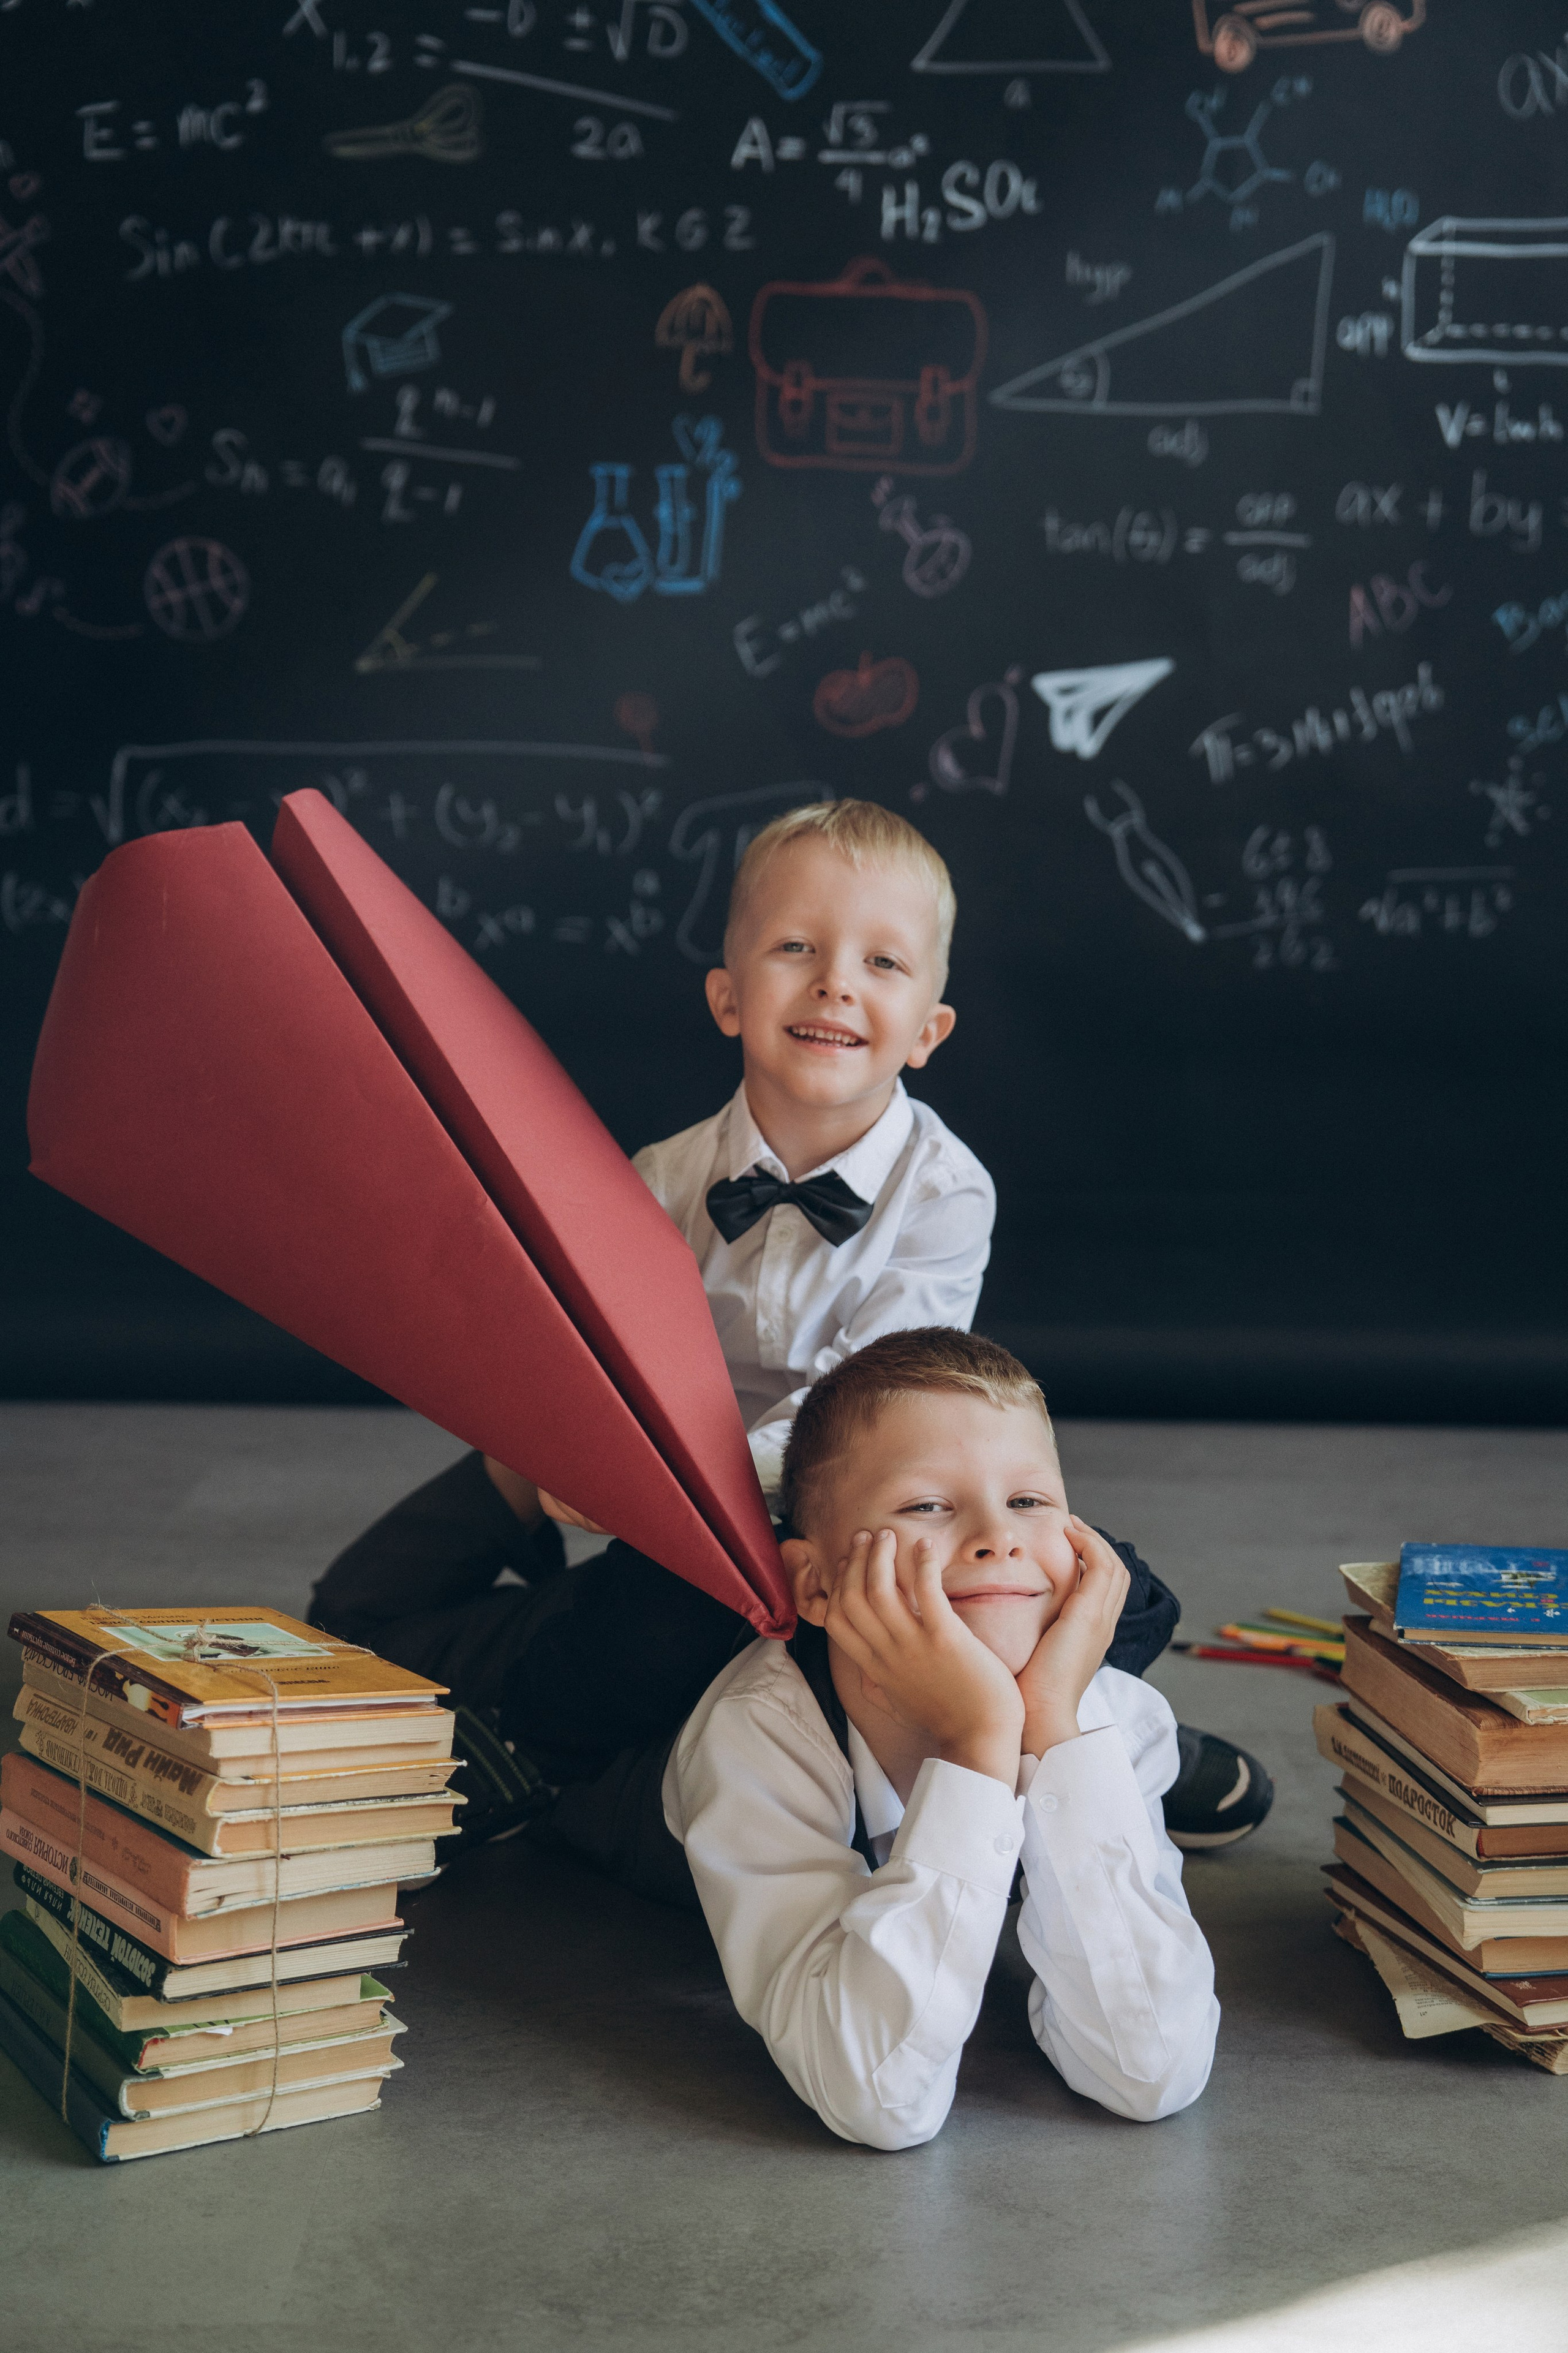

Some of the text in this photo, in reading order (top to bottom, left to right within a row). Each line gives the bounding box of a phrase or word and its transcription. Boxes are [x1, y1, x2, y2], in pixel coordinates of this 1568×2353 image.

[26, 1698, 205, 1796] Майн Рид КВАРТЕРОНКА
[1387, 1773, 1457, 1838] ПОДРОСТОК
[32, 1835, 69, 1875] ИСТОРИЯ
[21, 1874, 63, 1911] ИЛЬЯ ИЛЬФ
[110, 1932, 157, 1988] ЗОЛОТОЙ
